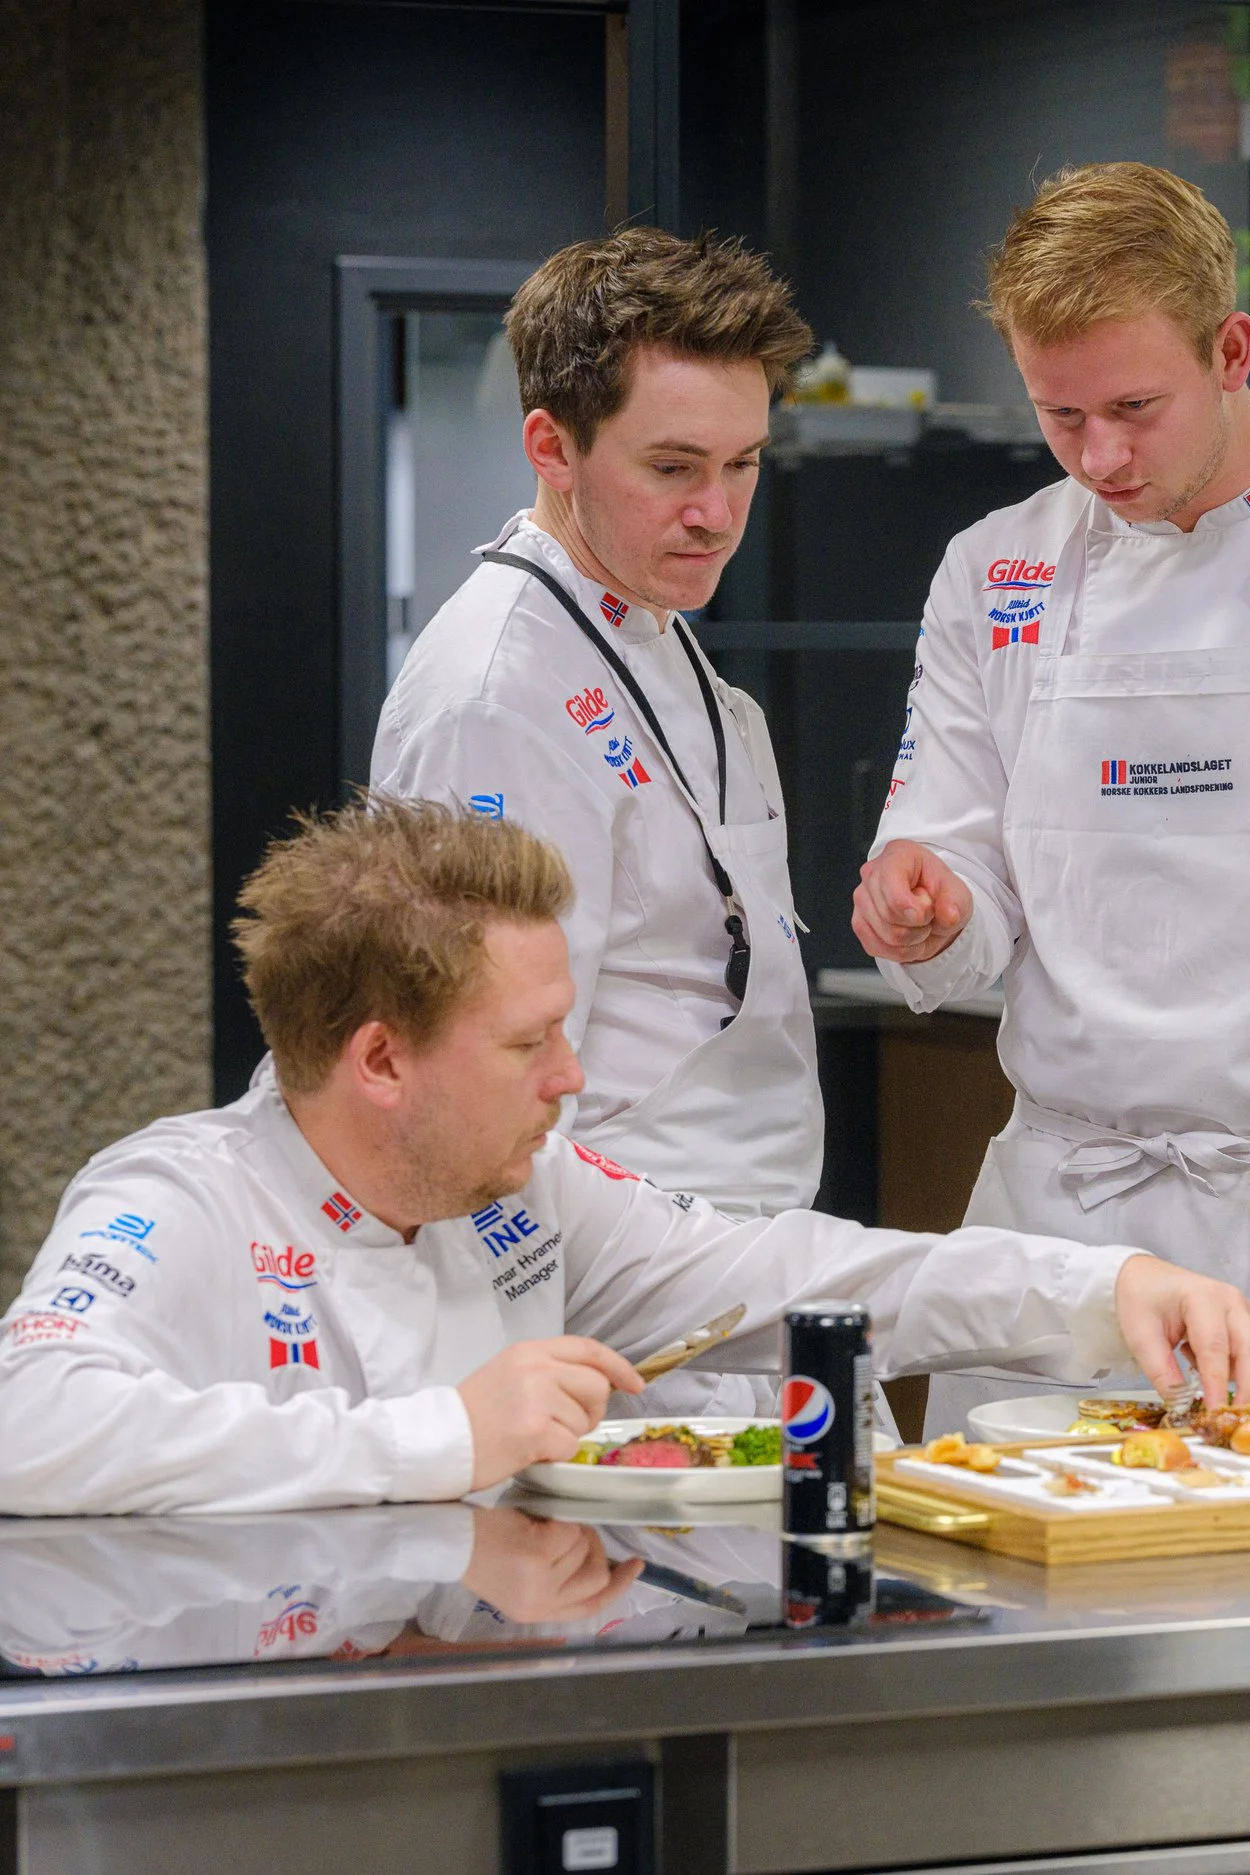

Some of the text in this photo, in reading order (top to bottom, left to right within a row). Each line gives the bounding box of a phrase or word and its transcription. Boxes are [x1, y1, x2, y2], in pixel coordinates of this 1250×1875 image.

[988, 559, 1056, 583] Gilde
[988, 601, 1046, 624] NORSK KJØTT
[565, 687, 609, 728] Gilde
[1129, 759, 1232, 775] KOKKELANDSLAGET
[1101, 782, 1233, 796] NORSKE KOKKERS LANDSFORENING
[1129, 776, 1158, 784] JUNIOR
[482, 1209, 540, 1258] INE
[250, 1241, 316, 1277] Gilde
[505, 1258, 560, 1302] Manager
